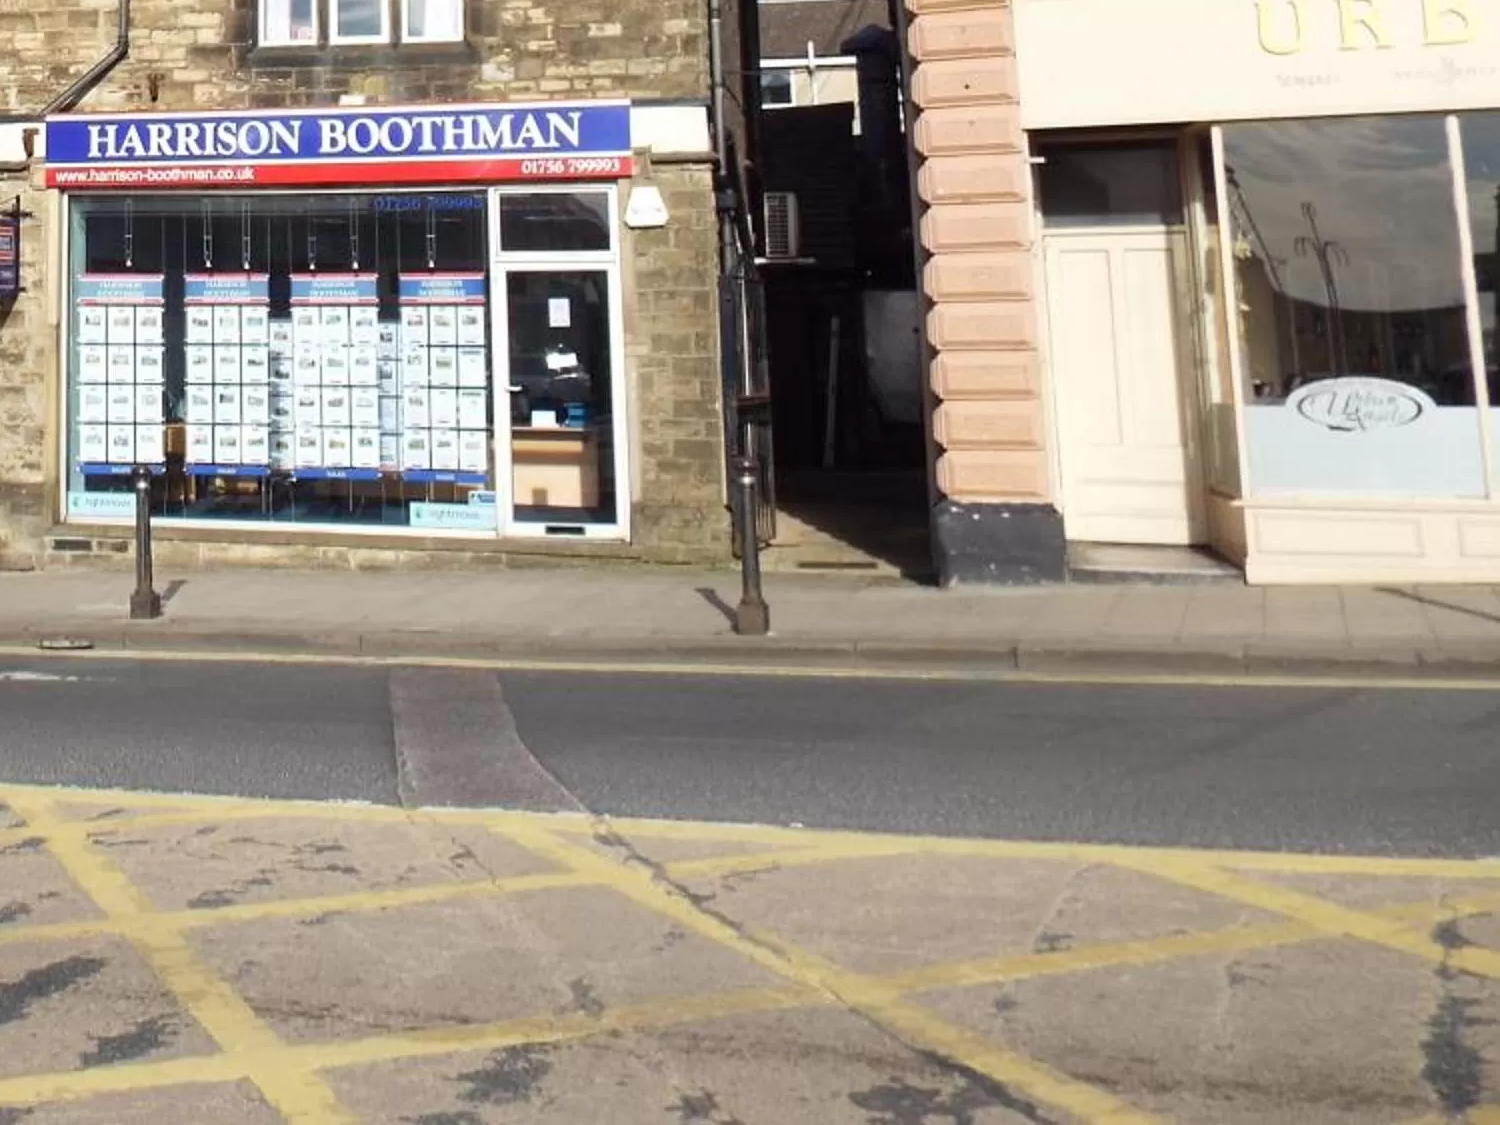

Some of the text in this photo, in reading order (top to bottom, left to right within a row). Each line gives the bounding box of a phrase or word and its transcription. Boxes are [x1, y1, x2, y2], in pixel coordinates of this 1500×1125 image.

[87, 111, 581, 158] HARRISON BOOTHMAN
[55, 166, 255, 183] www.harrison-boothman.co.uk
[521, 158, 621, 174] 01756 799993
